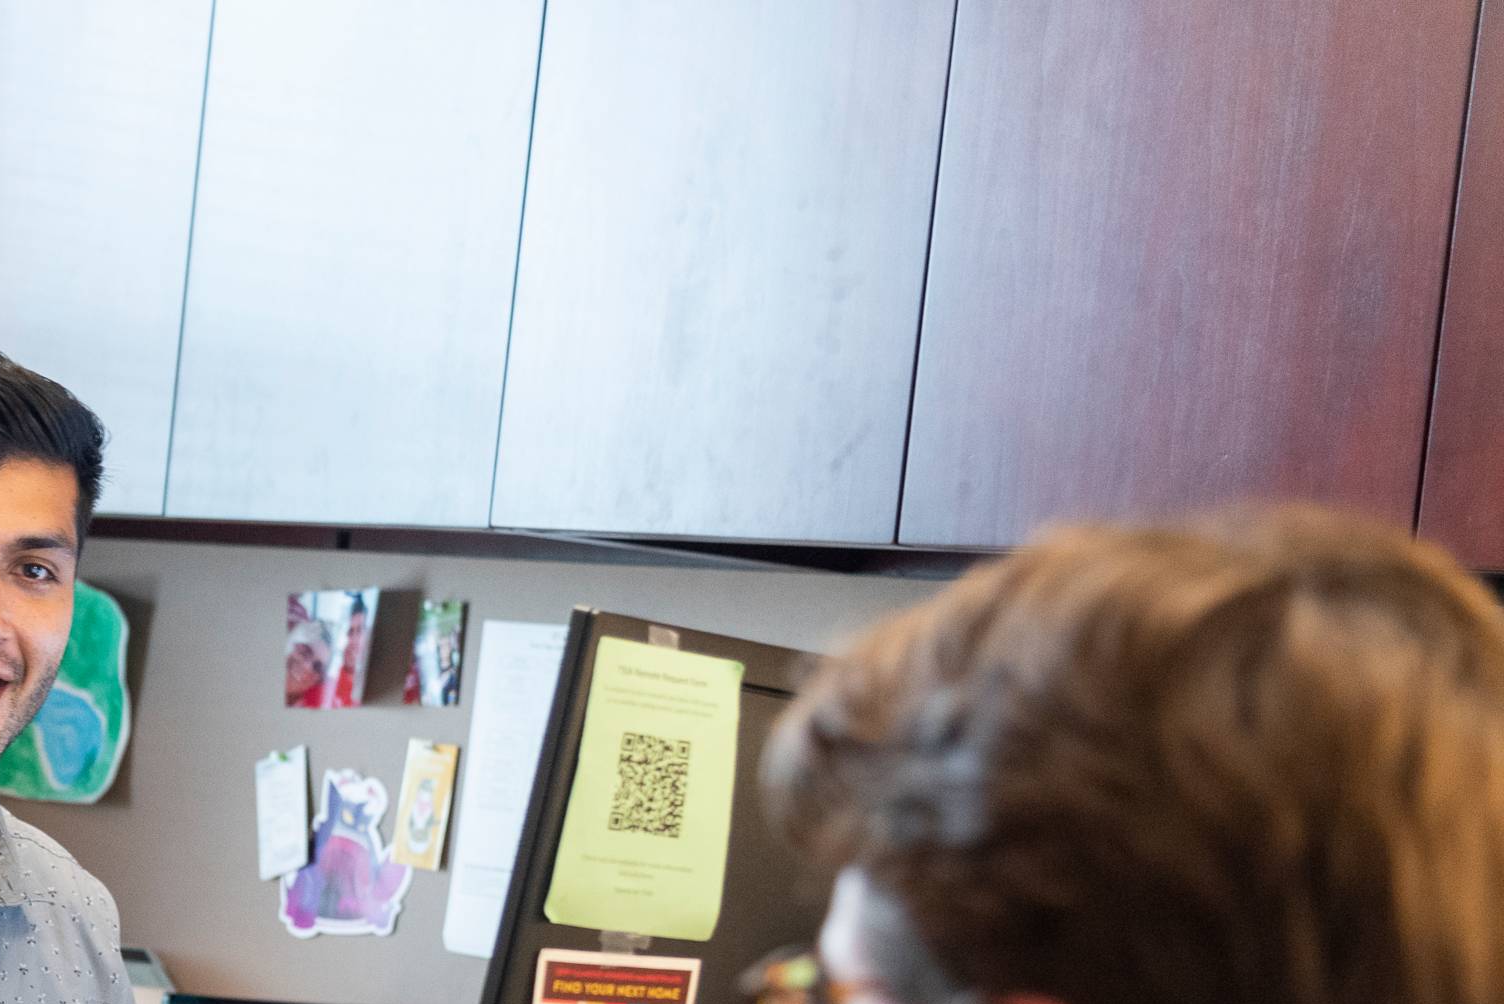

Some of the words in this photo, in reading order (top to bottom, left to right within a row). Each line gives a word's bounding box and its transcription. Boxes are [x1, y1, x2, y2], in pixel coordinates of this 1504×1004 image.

[553, 979, 583, 994] FIND
[584, 981, 615, 996] YOUR
[616, 984, 647, 998] NEXT
[647, 986, 681, 1000] HOME
